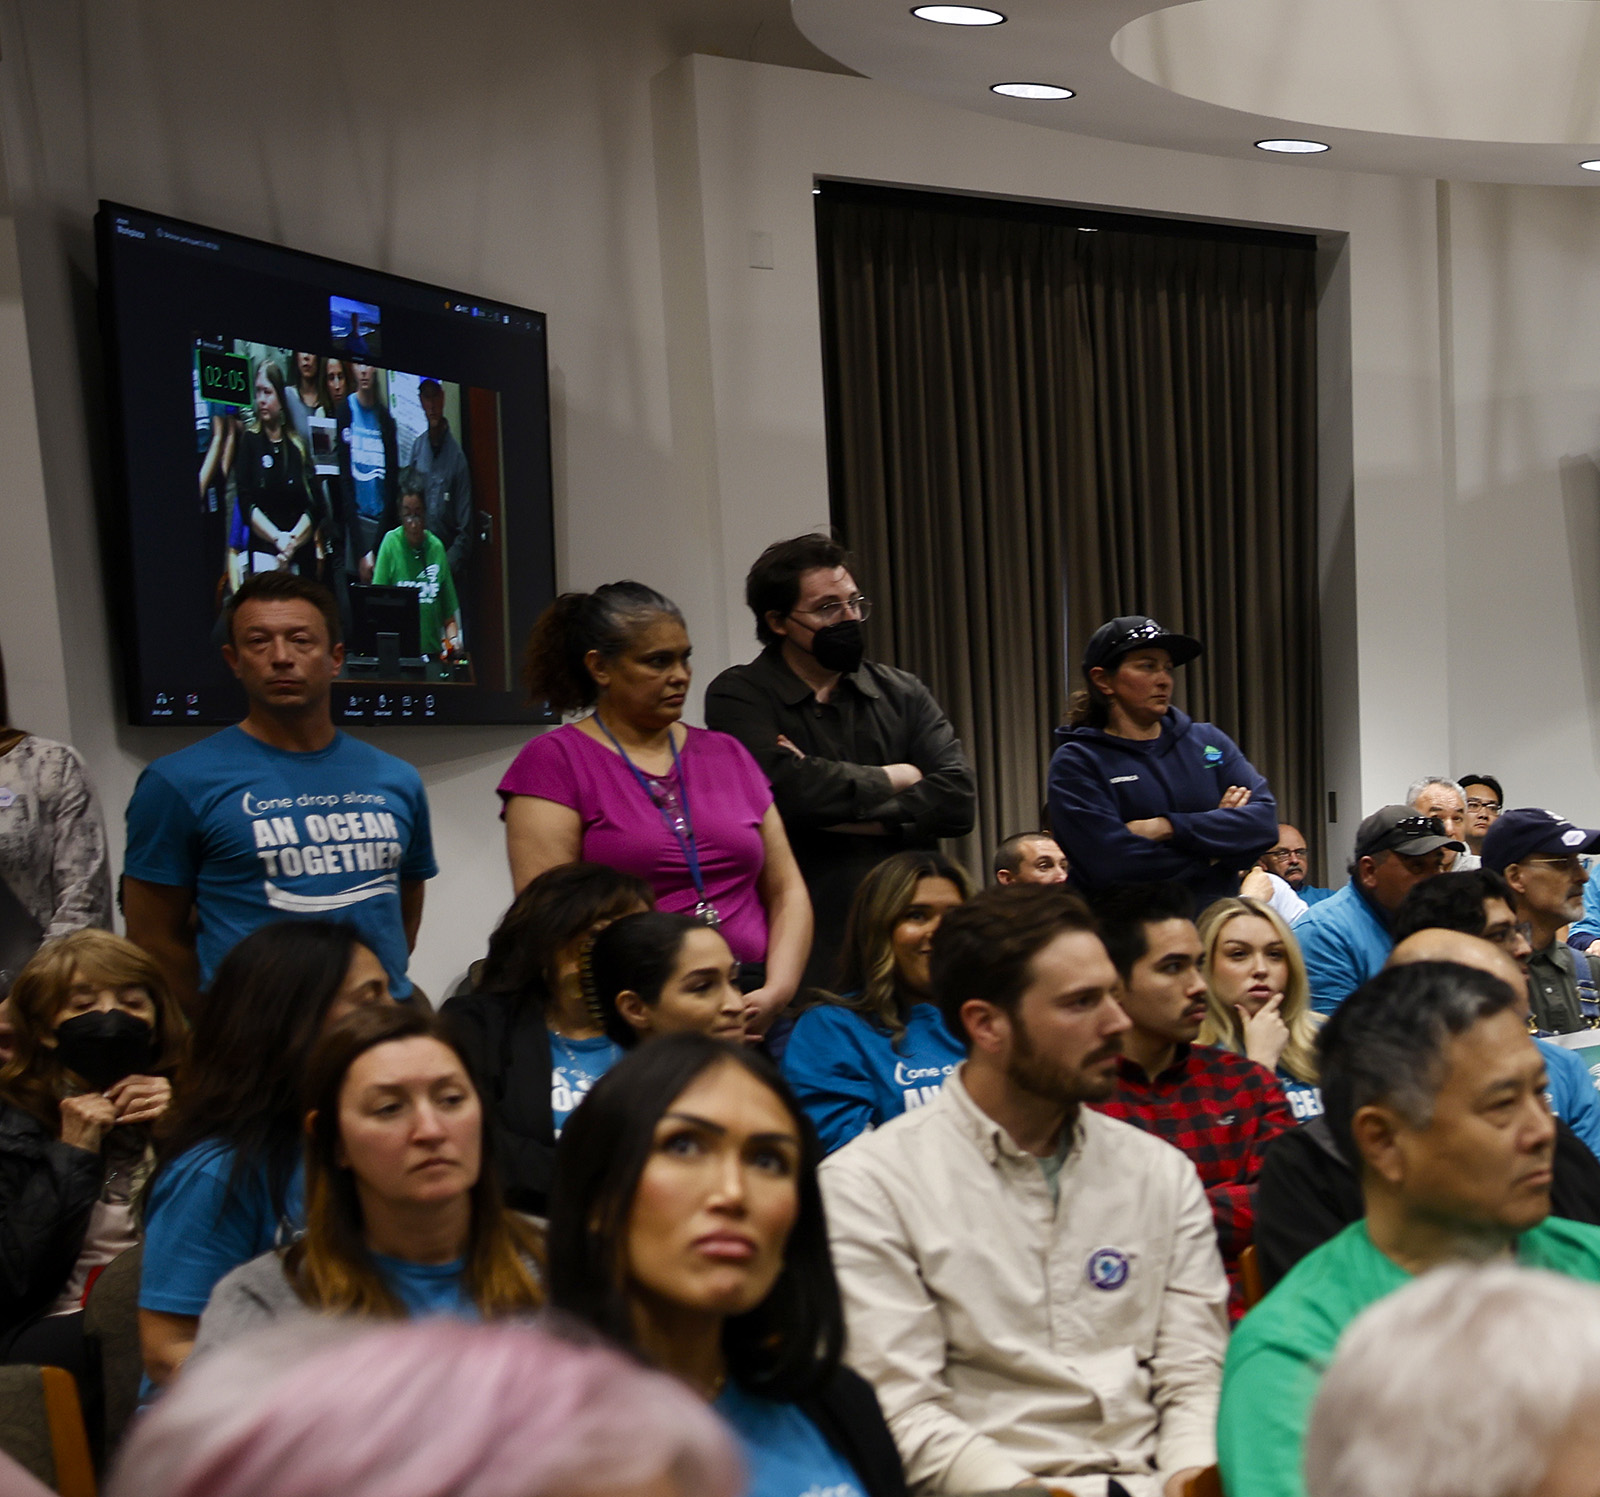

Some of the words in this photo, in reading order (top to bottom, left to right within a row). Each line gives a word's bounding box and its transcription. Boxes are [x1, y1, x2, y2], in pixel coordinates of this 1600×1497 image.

[204, 364, 246, 392] 02:05
[255, 796, 294, 810] one
[296, 793, 340, 809] drop
[342, 791, 387, 806] alone
[251, 816, 296, 848] AN
[305, 812, 398, 842] OCEAN
[257, 842, 401, 878] TOGETHER
[906, 1067, 941, 1079] one
